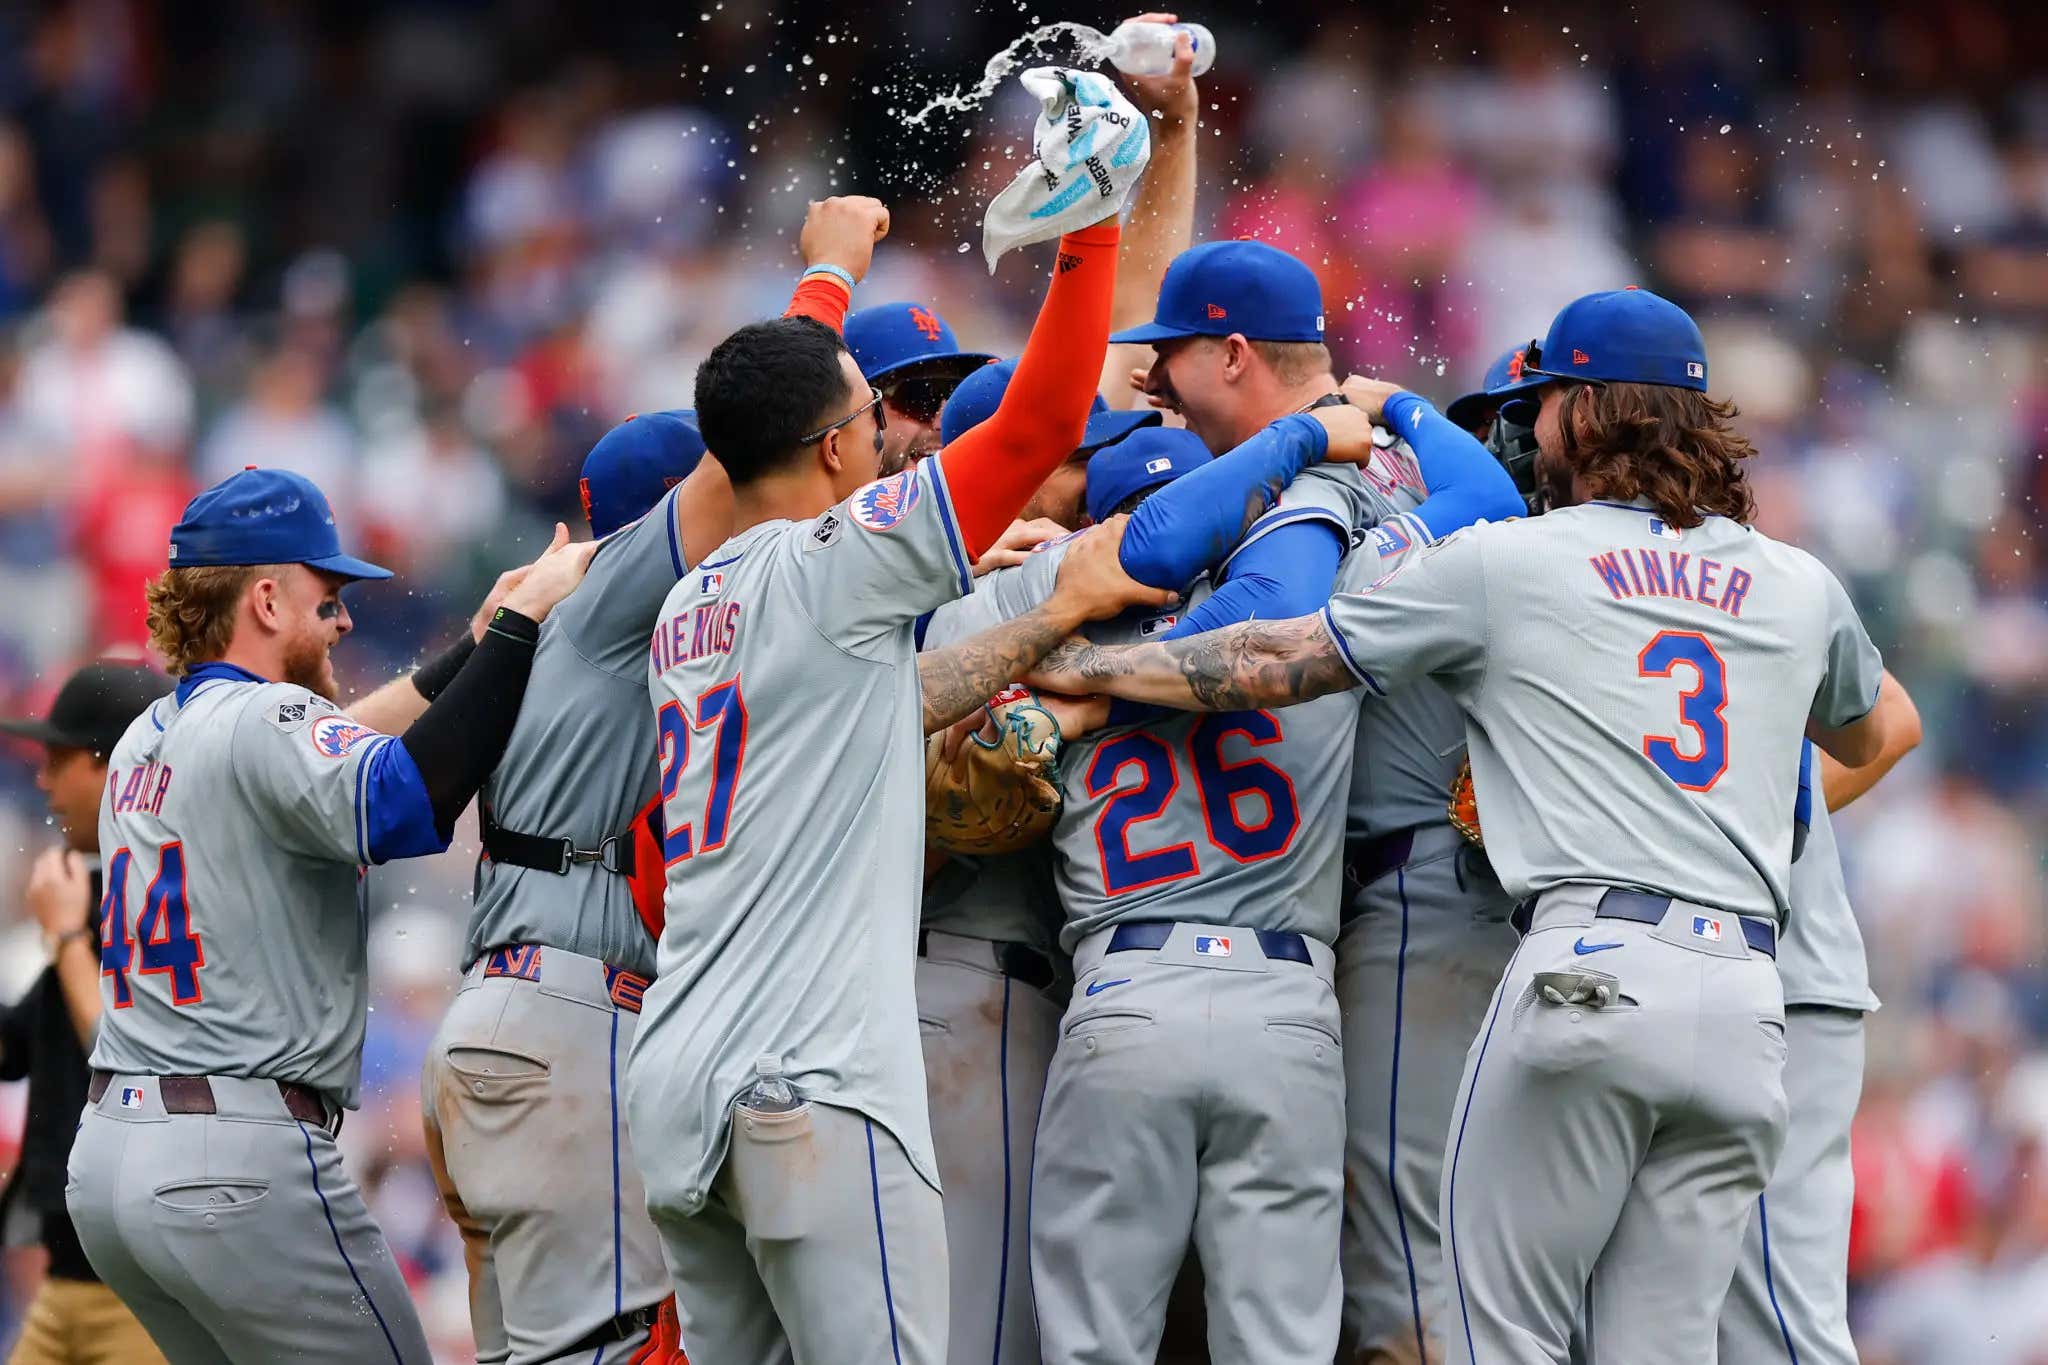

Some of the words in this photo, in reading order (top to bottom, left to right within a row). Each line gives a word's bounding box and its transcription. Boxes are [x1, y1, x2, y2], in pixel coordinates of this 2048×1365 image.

[1589, 548, 1752, 618] WINKER
[657, 671, 749, 871] 27
[1637, 629, 1729, 793] 3
[1084, 707, 1301, 897] 26
[100, 840, 206, 1009] 44
